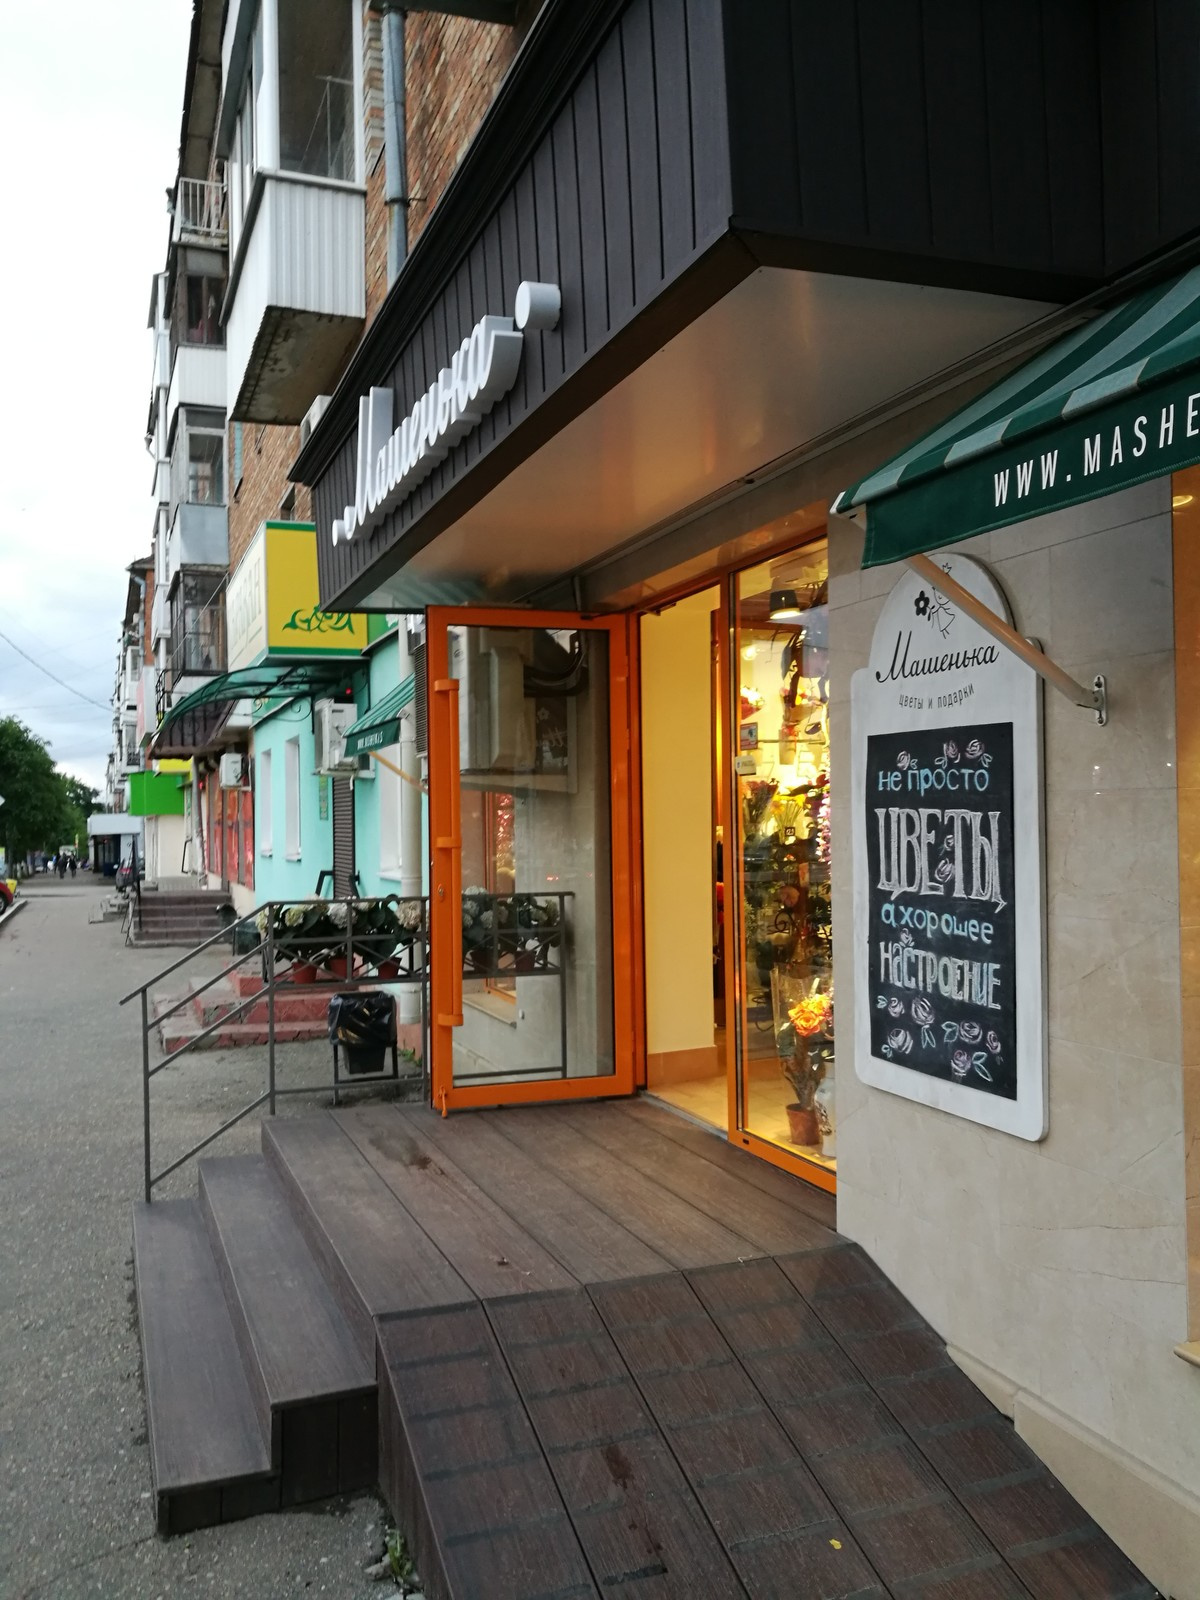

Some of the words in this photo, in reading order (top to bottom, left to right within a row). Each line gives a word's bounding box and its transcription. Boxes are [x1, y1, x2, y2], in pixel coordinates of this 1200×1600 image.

[332, 314, 524, 547] Машенька
[875, 630, 1000, 683] Машенька
[899, 694, 924, 710] цветы
[937, 683, 975, 709] подарки
[877, 770, 902, 792] не
[907, 767, 990, 797] просто
[874, 807, 1008, 914] ЦВЕТЫ
[899, 904, 995, 945] хорошее
